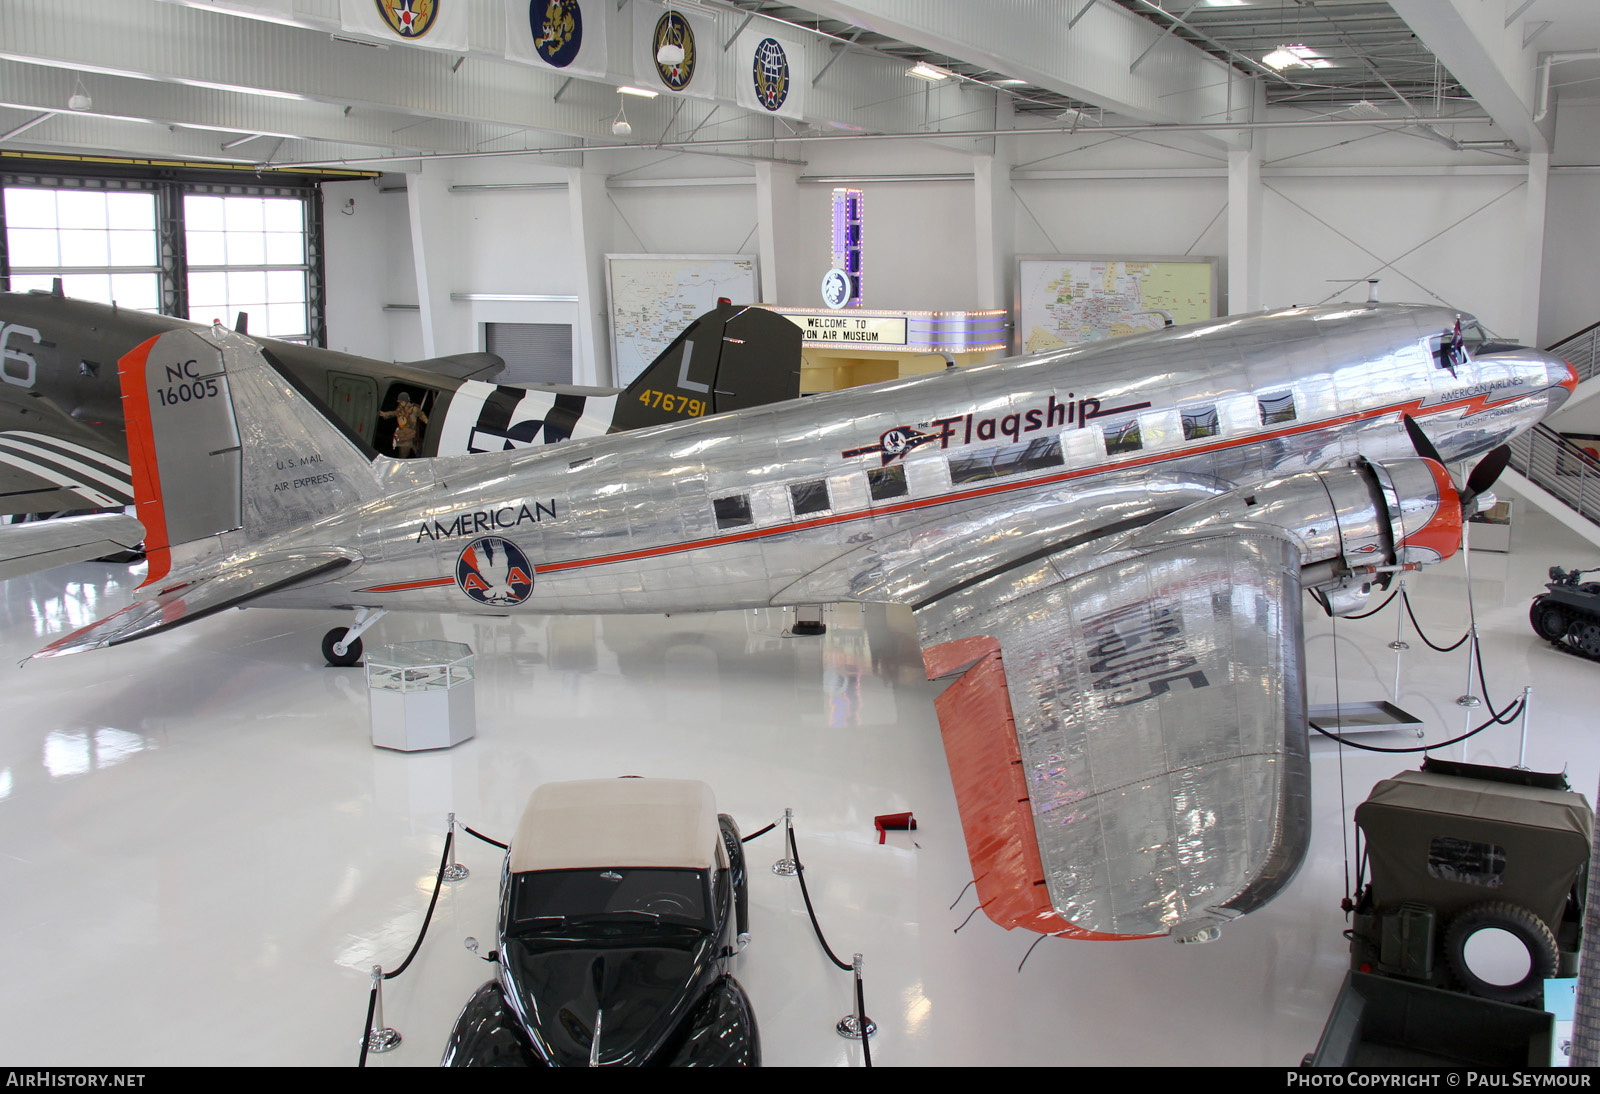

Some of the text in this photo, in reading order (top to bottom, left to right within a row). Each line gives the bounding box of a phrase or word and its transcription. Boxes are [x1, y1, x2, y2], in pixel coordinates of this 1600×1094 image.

[801, 330, 879, 341] YON AIR MUSEUM
[807, 318, 866, 329] WELCOME TO
[0, 320, 42, 388] 6
[677, 339, 709, 393] L
[165, 359, 199, 382] NC
[157, 379, 219, 406] 16005
[1440, 376, 1524, 401] AMERICAN AIRLINES
[639, 389, 706, 417] 476791
[1490, 405, 1519, 420] ORANGE
[931, 393, 1151, 450] Flagship
[300, 454, 323, 466] MAIL
[274, 473, 335, 492] AIR EXPRESS
[416, 498, 557, 543] AMERICAN
